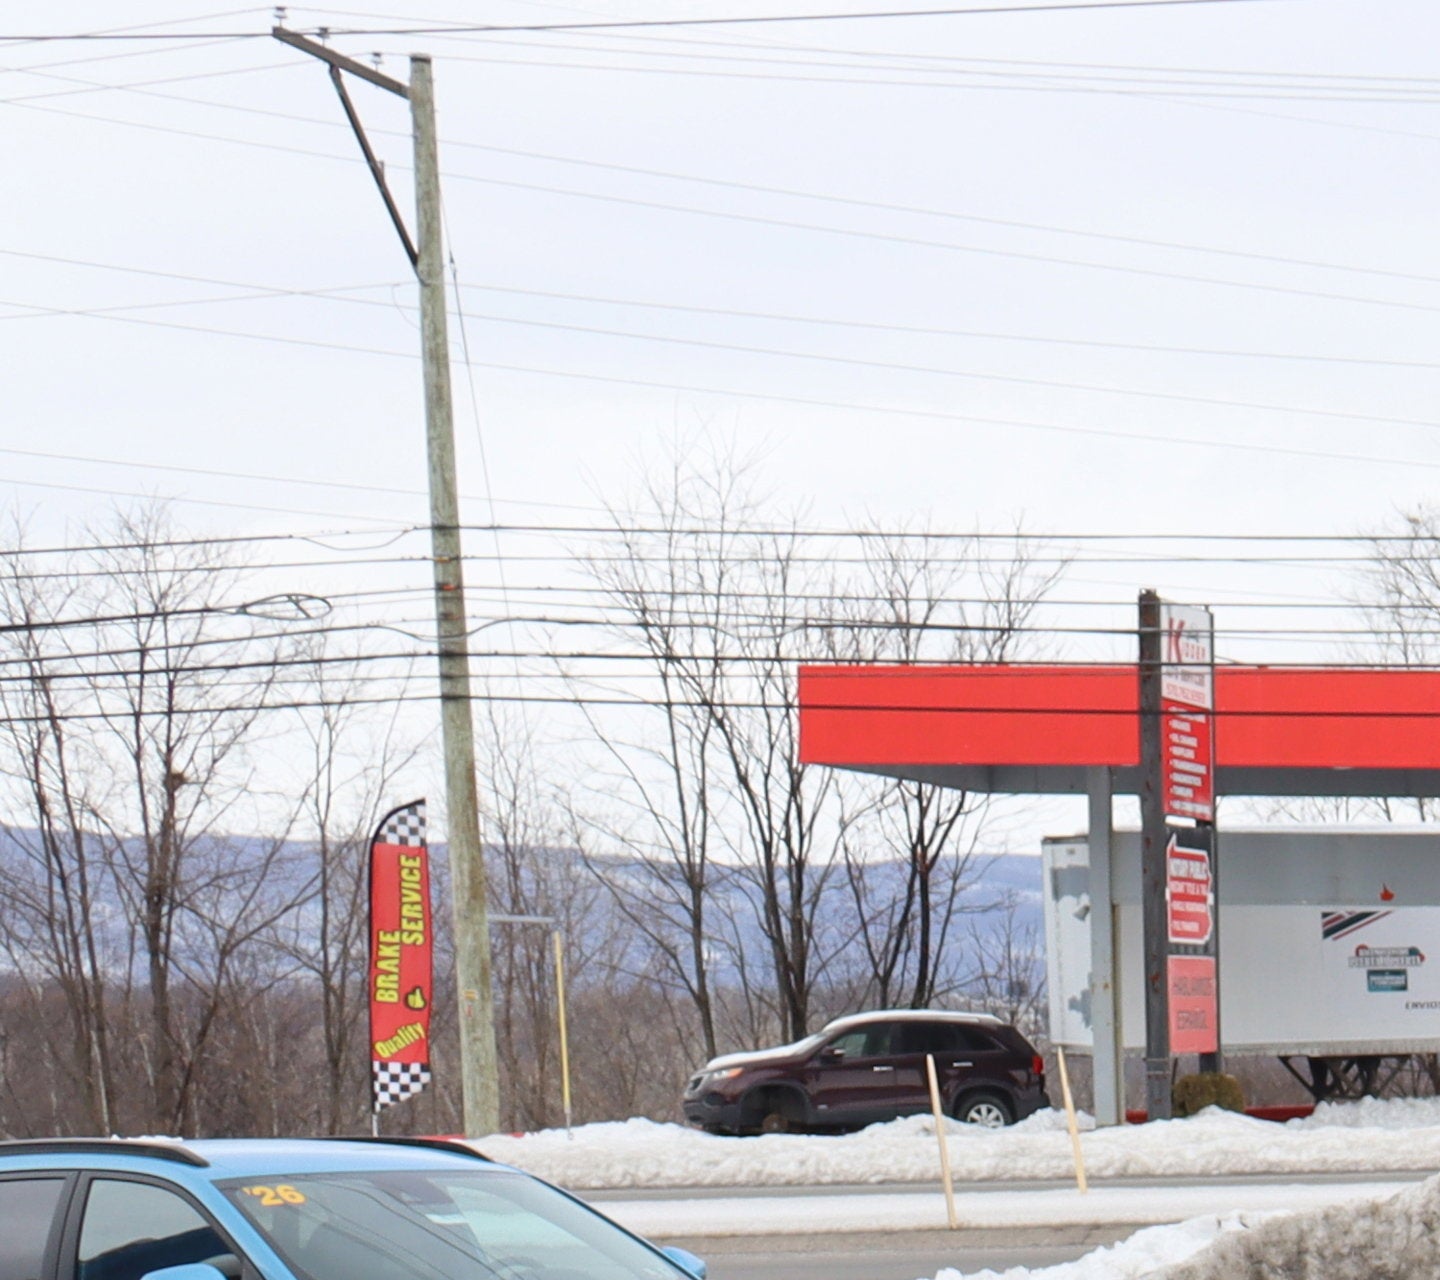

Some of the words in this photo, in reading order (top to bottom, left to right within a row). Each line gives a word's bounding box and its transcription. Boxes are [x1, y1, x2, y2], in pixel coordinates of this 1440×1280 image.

[400, 855, 424, 945] SERVICE
[375, 930, 400, 1003] BRAKE
[374, 1022, 425, 1058] Quality
